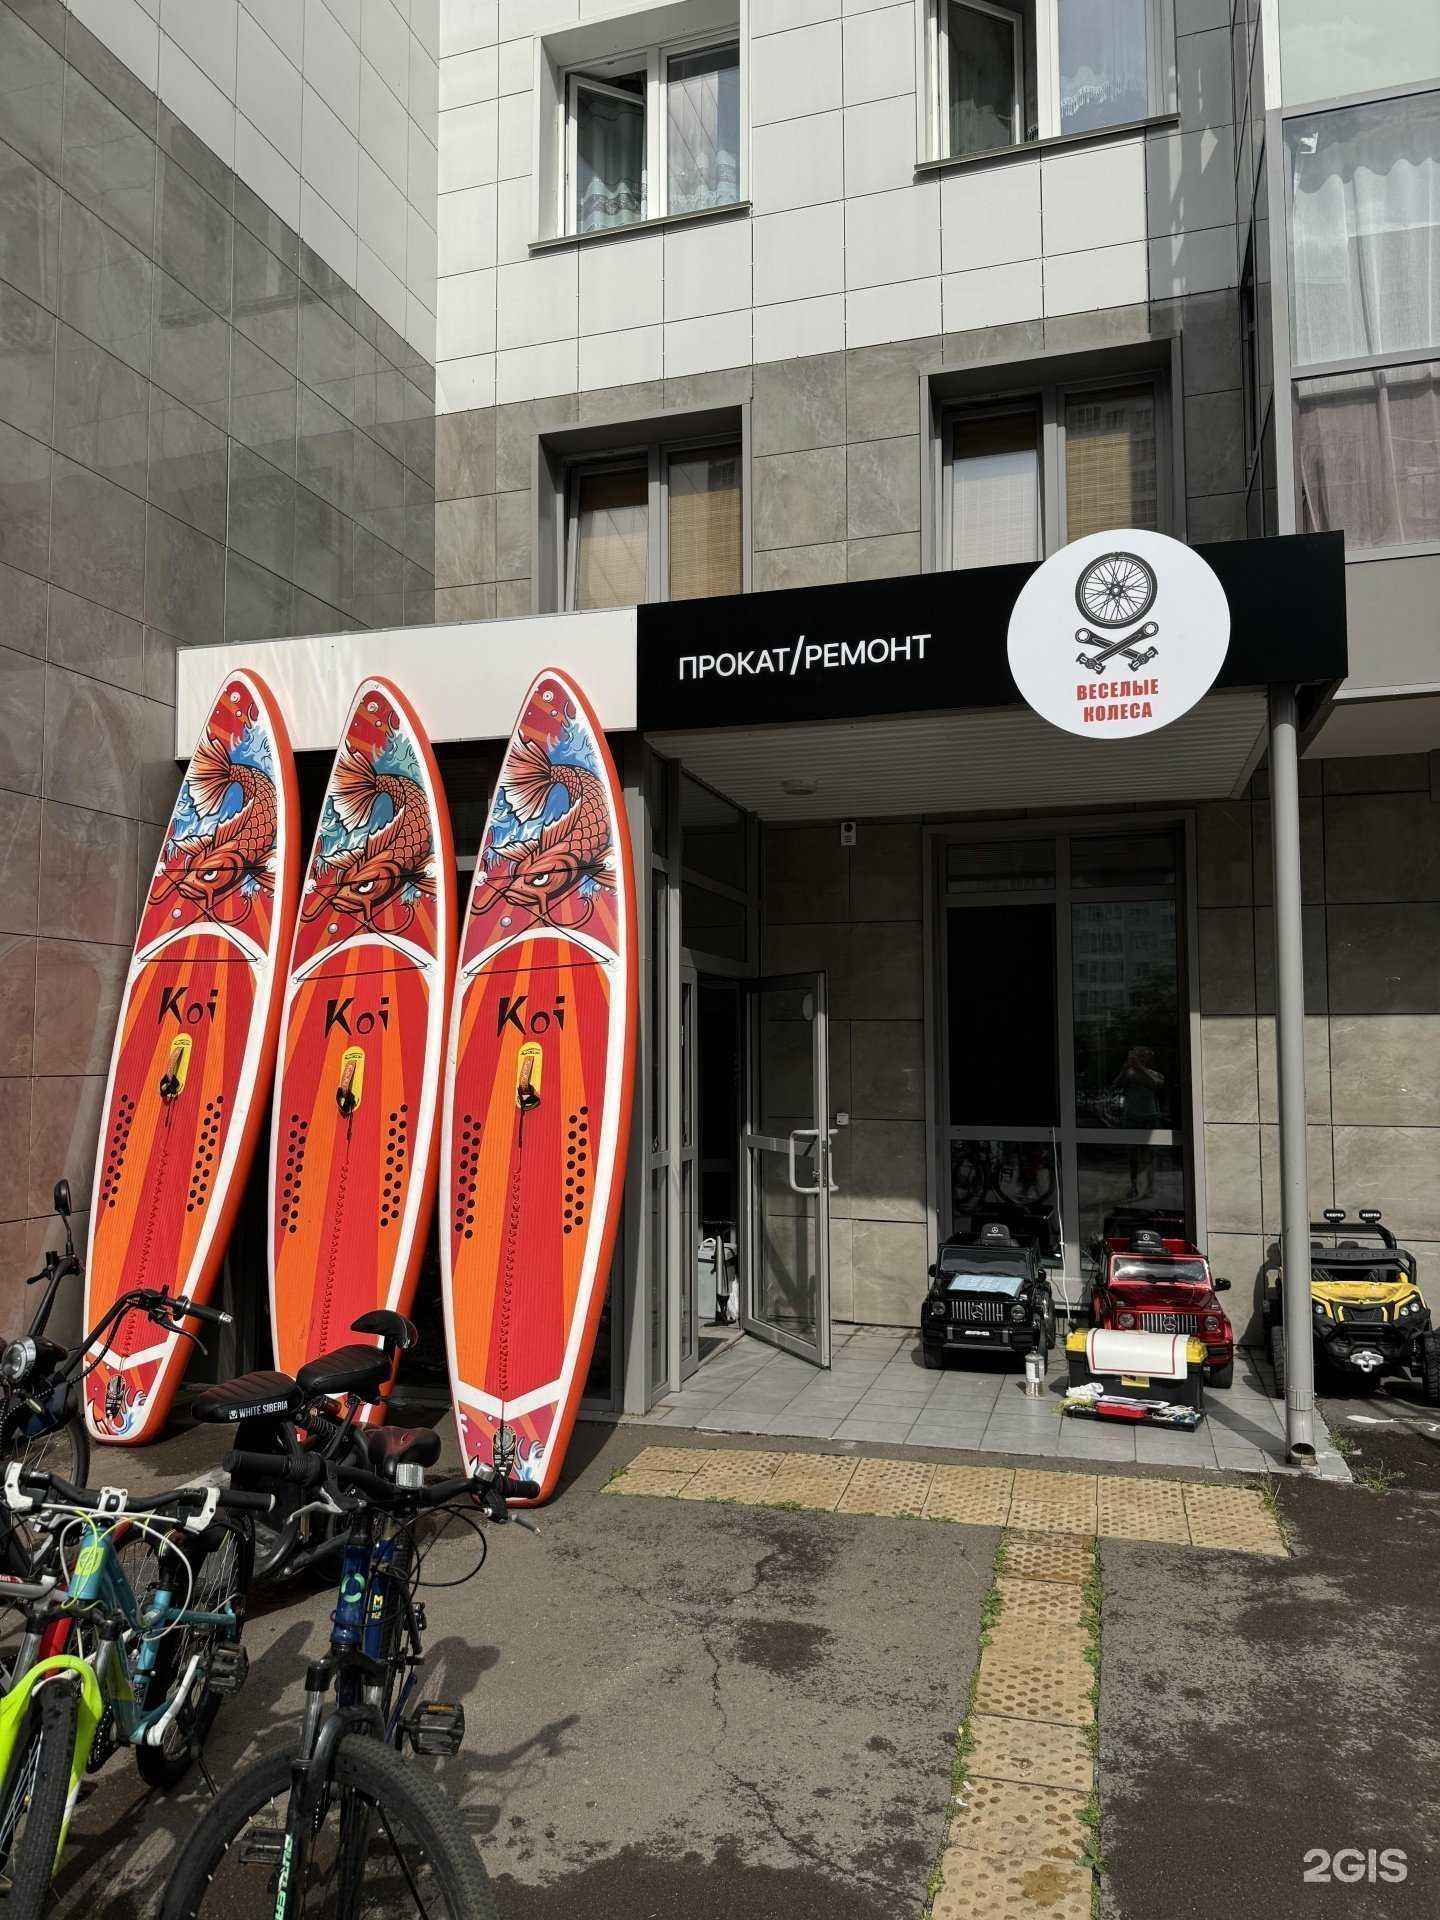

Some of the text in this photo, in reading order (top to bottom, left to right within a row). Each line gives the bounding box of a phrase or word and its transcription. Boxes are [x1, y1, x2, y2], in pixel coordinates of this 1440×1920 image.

[679, 634, 932, 680] ПРОКАТ/РЕМОНТ
[1076, 678, 1159, 700] ВЕСЕЛЫЕ
[1083, 702, 1152, 722] КОЛЕСА
[157, 986, 219, 1025] Koi
[324, 996, 390, 1039] Koi
[496, 995, 565, 1038] Koi
[239, 1400, 289, 1418] WHITE SIBERIA
